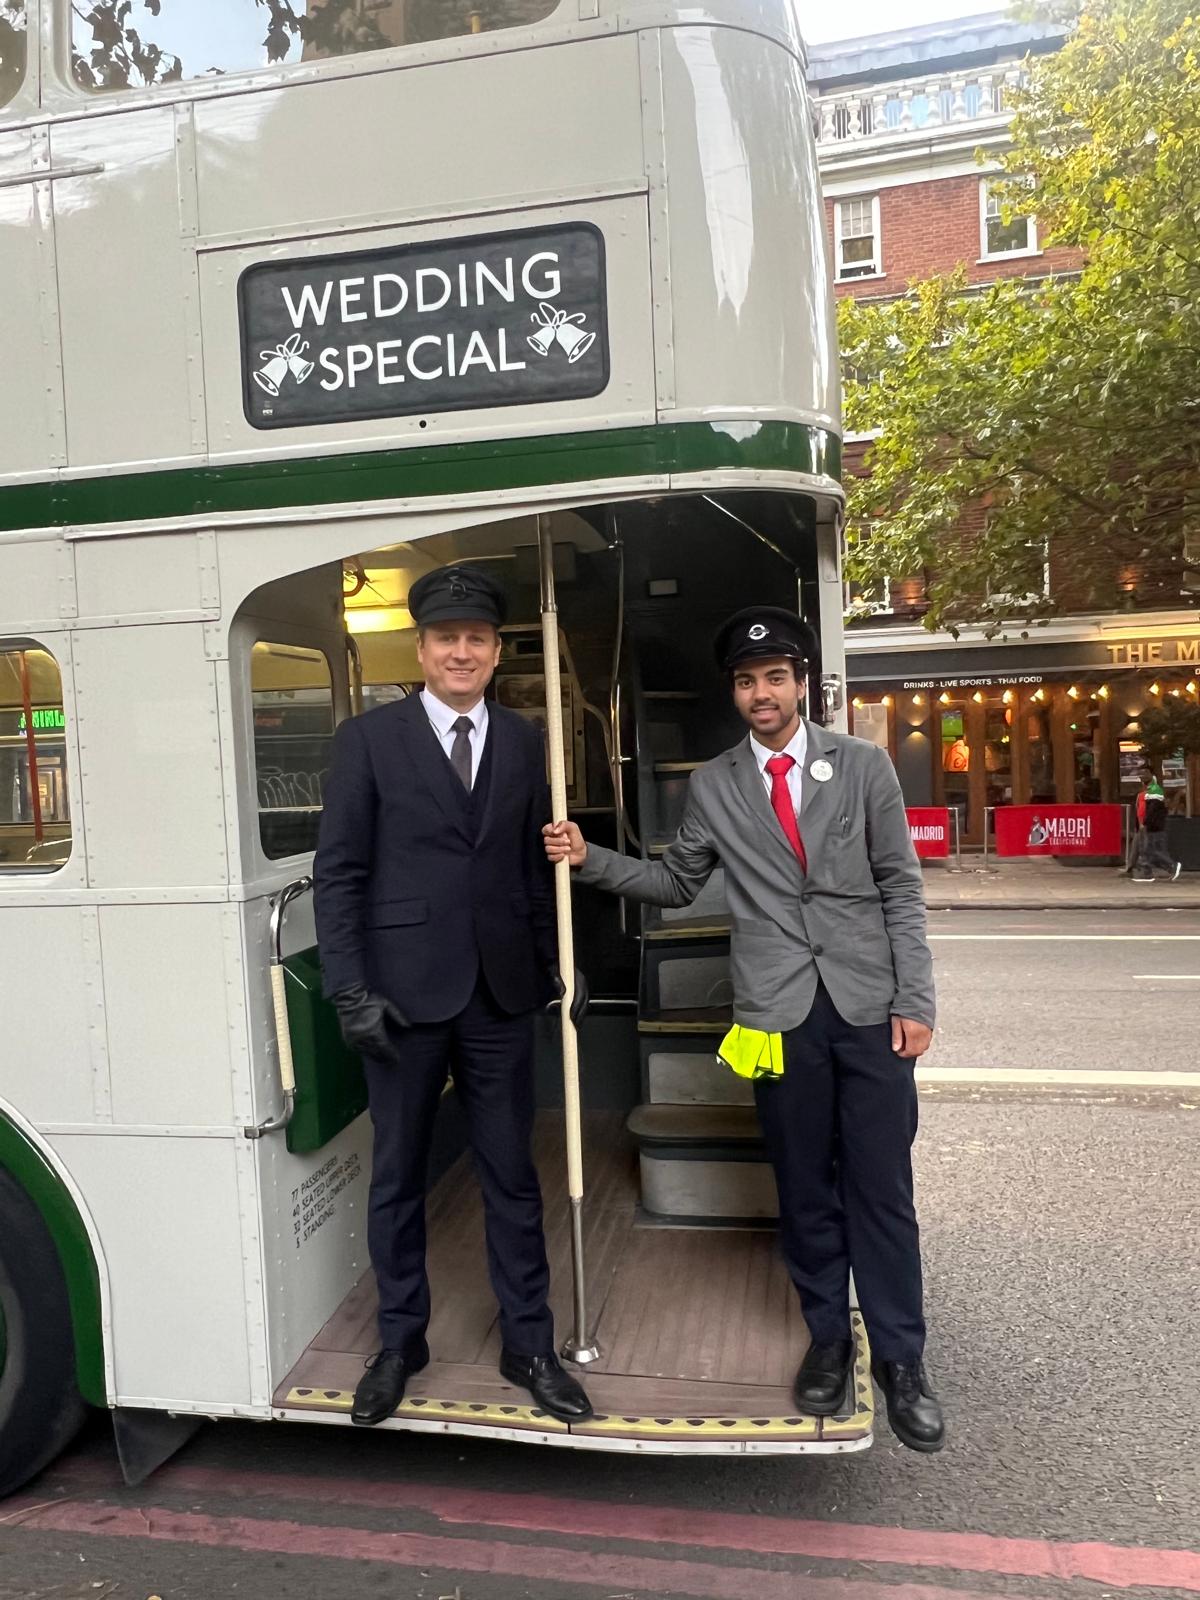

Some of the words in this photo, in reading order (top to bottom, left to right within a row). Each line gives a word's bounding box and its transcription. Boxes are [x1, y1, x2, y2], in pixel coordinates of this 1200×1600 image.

[281, 251, 561, 328] WEDDING
[319, 328, 526, 391] SPECIAL
[1107, 642, 1163, 664] THE
[1177, 640, 1200, 662] M
[903, 680, 935, 689] DRINKS
[940, 679, 958, 688] LIVE
[959, 678, 992, 687] SPORTS
[998, 676, 1017, 685] THAI
[1018, 676, 1043, 684] FOOD
[910, 825, 944, 841] MADRID
[291, 1187, 299, 1202] 77
[302, 1182, 326, 1211] SEATED
[302, 1197, 326, 1226] SEATED
[303, 1203, 336, 1242] STANDING
